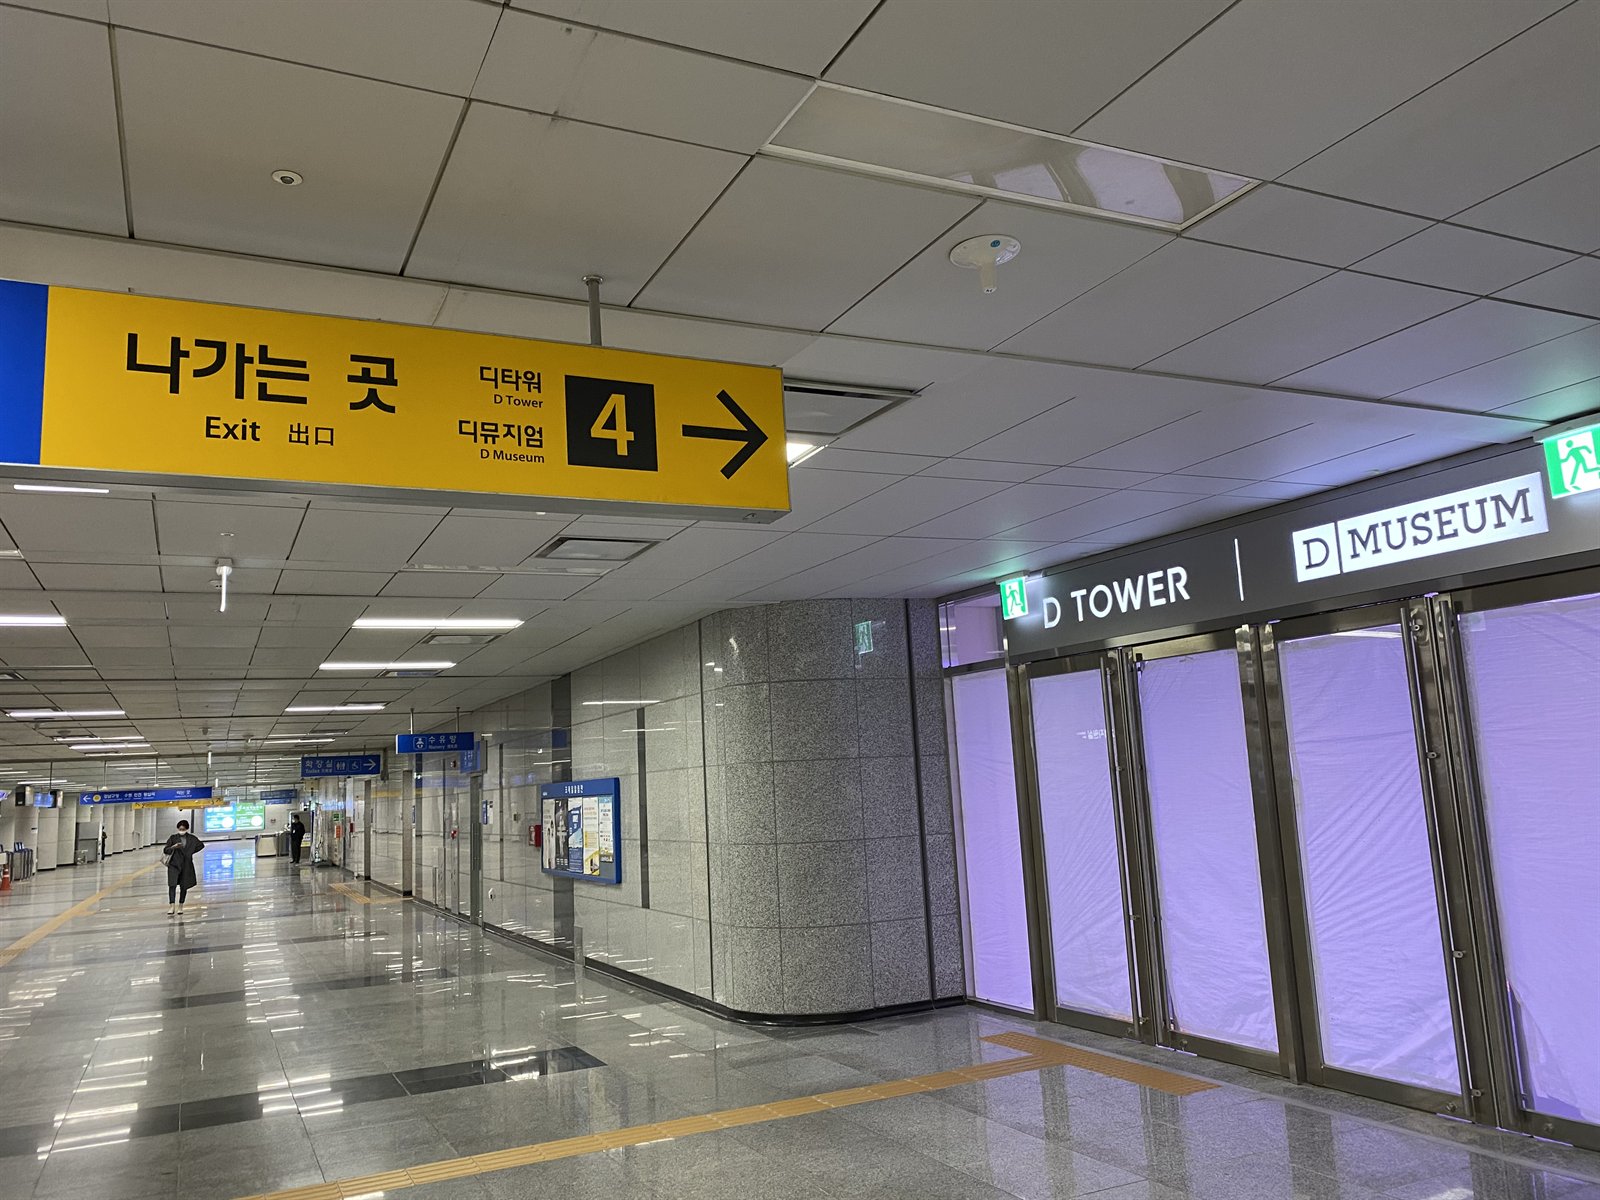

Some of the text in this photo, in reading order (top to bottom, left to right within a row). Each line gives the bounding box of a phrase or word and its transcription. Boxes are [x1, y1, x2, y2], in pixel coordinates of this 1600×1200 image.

[127, 332, 398, 413] 나가는 곳
[480, 366, 542, 393] 디타워
[493, 393, 544, 409] D Tower
[206, 416, 261, 441] Exit
[289, 423, 335, 446] 出口
[458, 419, 544, 448] 디뮤지엄
[590, 393, 635, 456] 4
[480, 448, 545, 463] D Museum
[1303, 487, 1535, 570] D MUSEUM
[1042, 565, 1190, 629] D TOWER
[305, 759, 333, 768] 화장실
